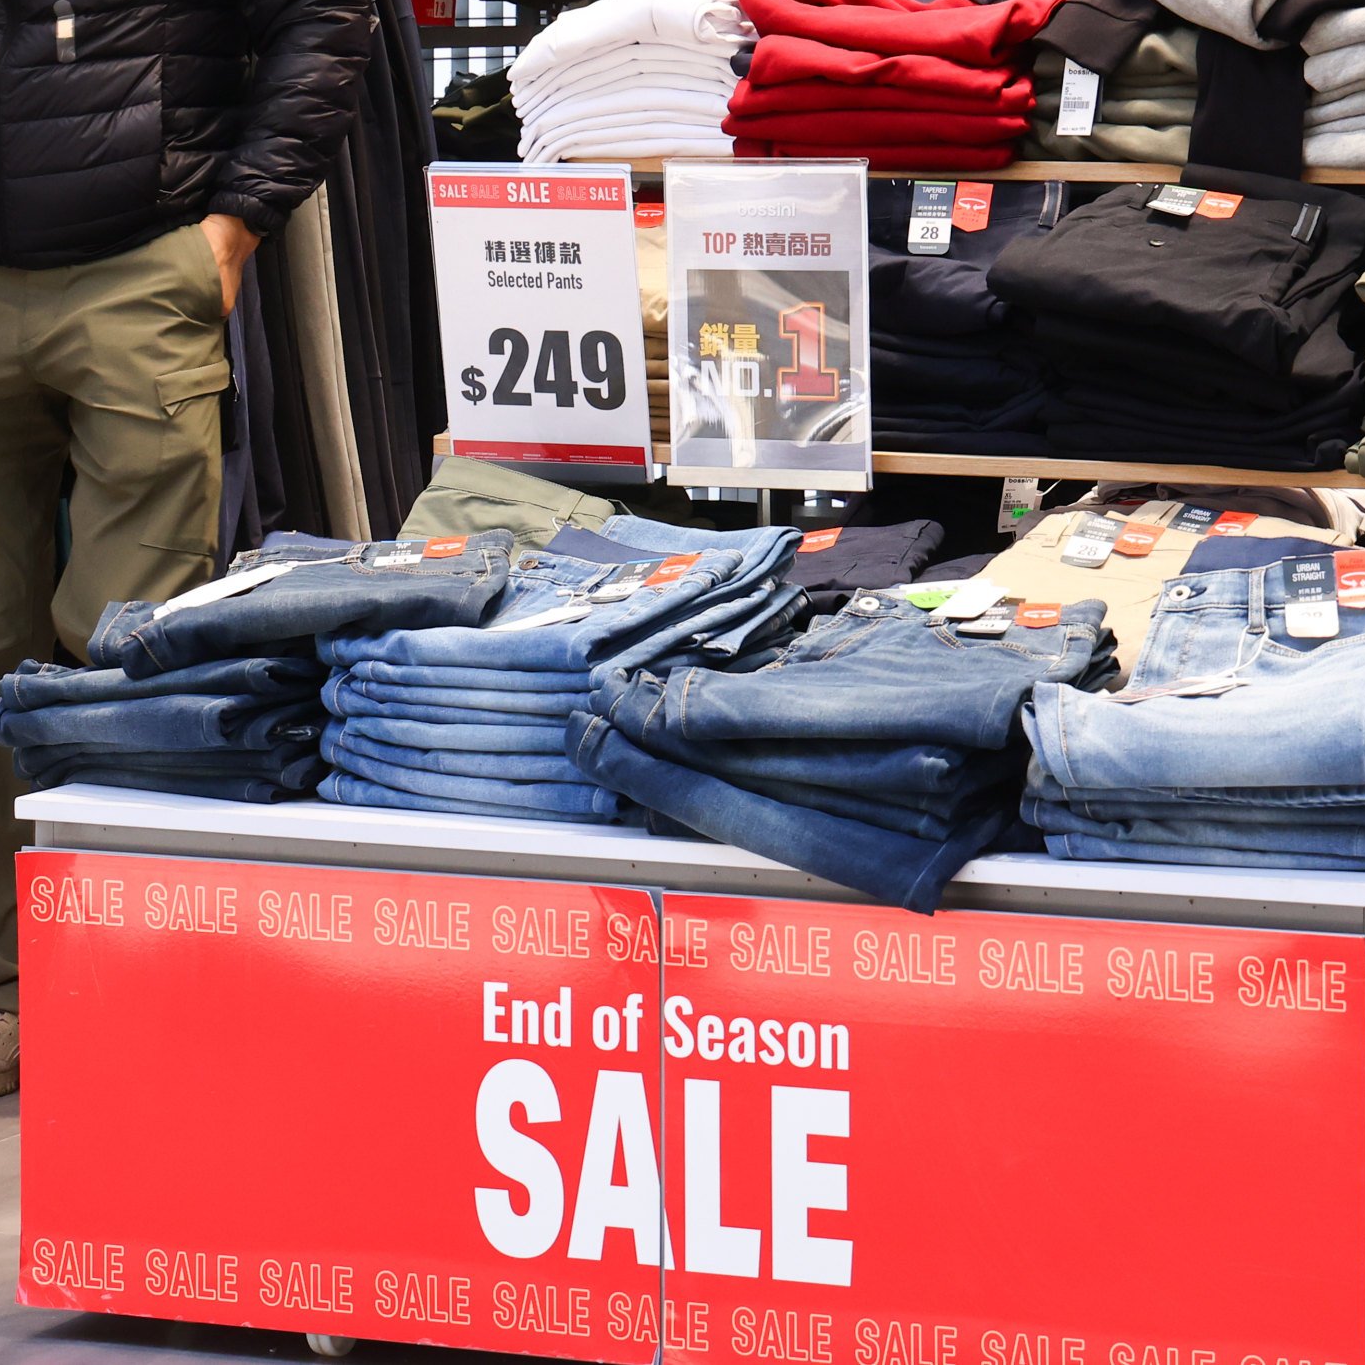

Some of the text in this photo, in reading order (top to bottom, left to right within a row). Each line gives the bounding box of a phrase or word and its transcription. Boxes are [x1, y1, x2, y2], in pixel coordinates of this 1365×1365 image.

[439, 182, 618, 203] SALE SALE SALE SALE SALE
[738, 201, 795, 217] bossini
[920, 226, 939, 239] 28
[485, 240, 582, 265] 精選褲款
[703, 232, 831, 256] TOP 熱賣商品
[488, 271, 583, 290] Selected Pants
[699, 322, 761, 358] 銷量
[701, 301, 839, 402] NO. 1
[461, 327, 626, 410] $249
[1183, 512, 1211, 522] STRAIGHT
[1191, 508, 1211, 517] URBAN
[1077, 545, 1097, 556] 28
[1292, 571, 1326, 582] STRAIGHT
[1296, 563, 1320, 572] URBAN
[31, 876, 1347, 1013] SALE SALE SALE SALE SALE SALE SALE SALE SALE SALE SALE
[482, 981, 849, 1071] End of Season
[474, 1058, 853, 1288] SALE
[32, 1239, 124, 1292] SALE
[145, 1248, 237, 1303] SALE
[259, 1259, 353, 1314] SALE
[374, 1269, 470, 1325] SALE
[493, 1280, 589, 1337] SALE
[606, 1291, 708, 1352] SALE
[731, 1307, 832, 1364] SALE
[855, 1319, 957, 1365] SALE
